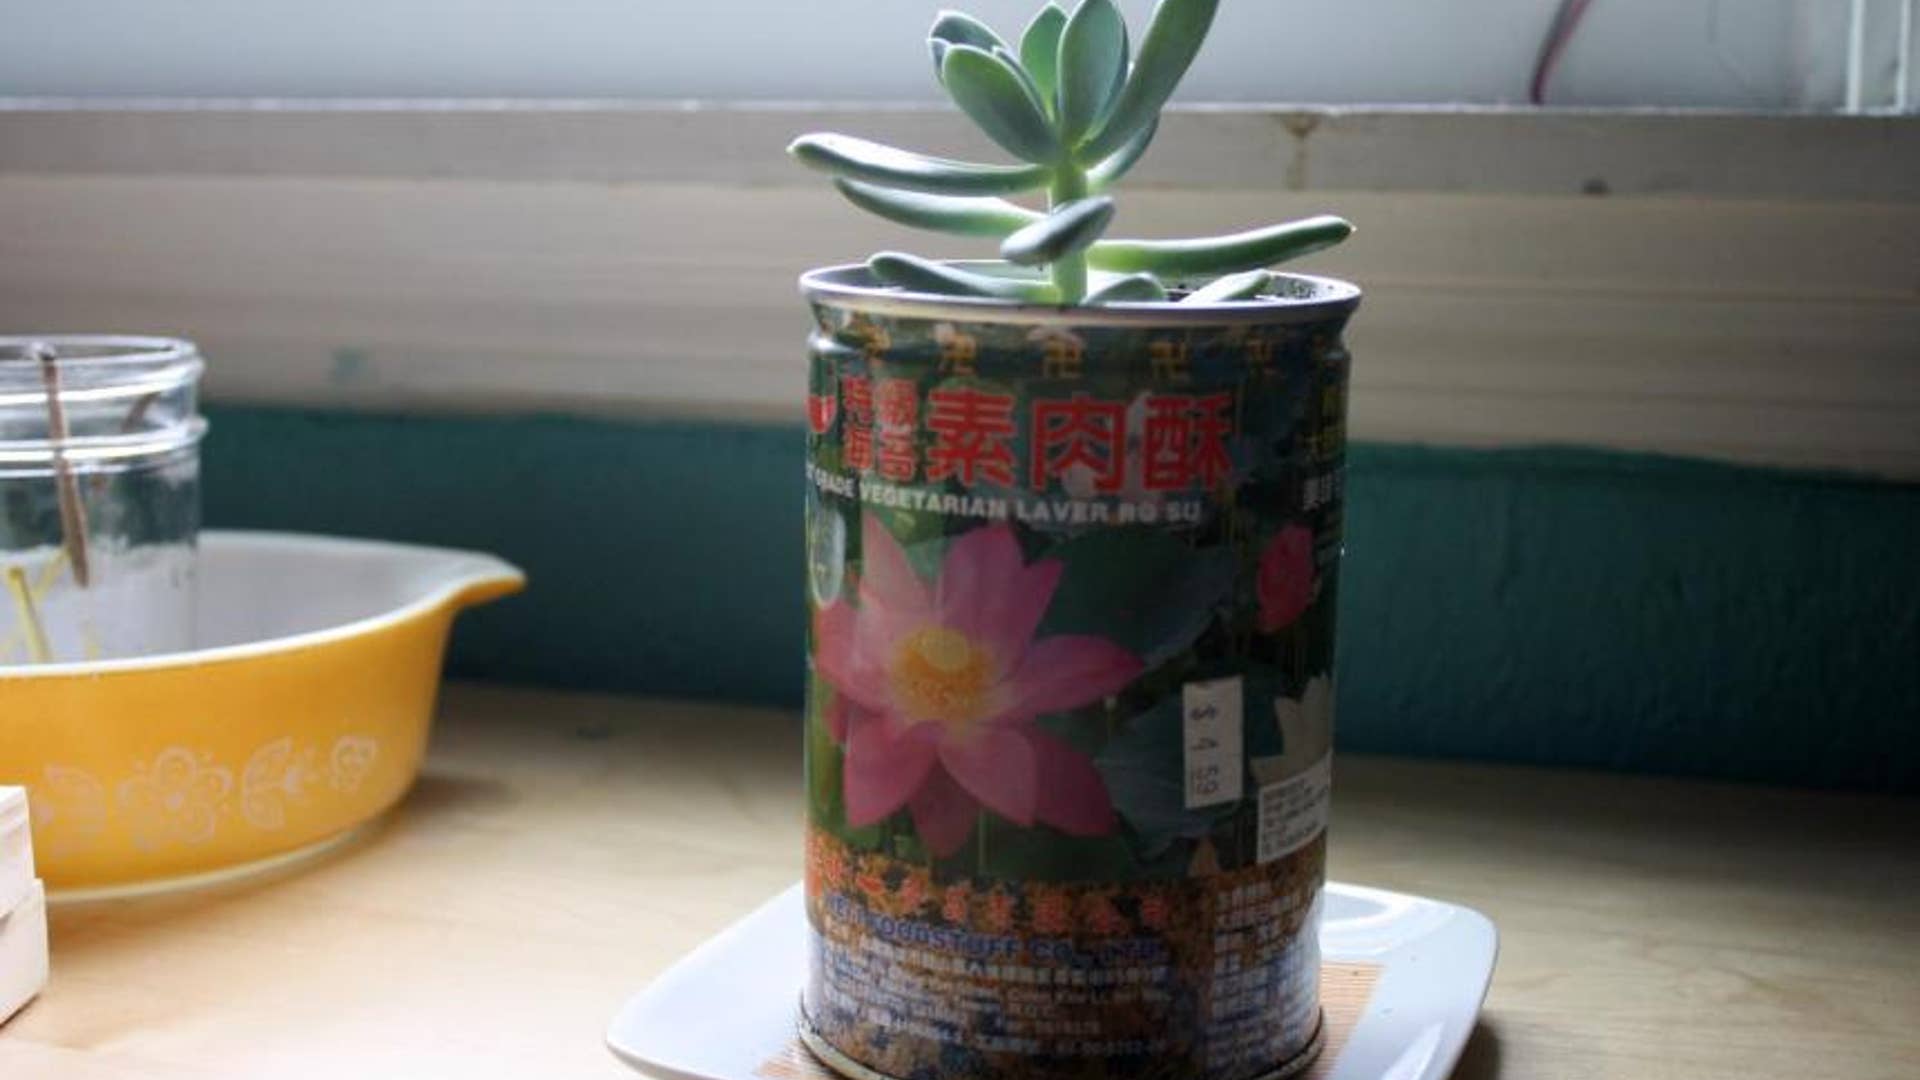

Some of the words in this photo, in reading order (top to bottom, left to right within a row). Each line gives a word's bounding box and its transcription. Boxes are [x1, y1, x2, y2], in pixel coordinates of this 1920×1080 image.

[925, 387, 1233, 493] 素肉酥
[860, 479, 1007, 521] VEGETARIAN
[1016, 501, 1111, 523] LAVER
[1168, 502, 1203, 525] SU
